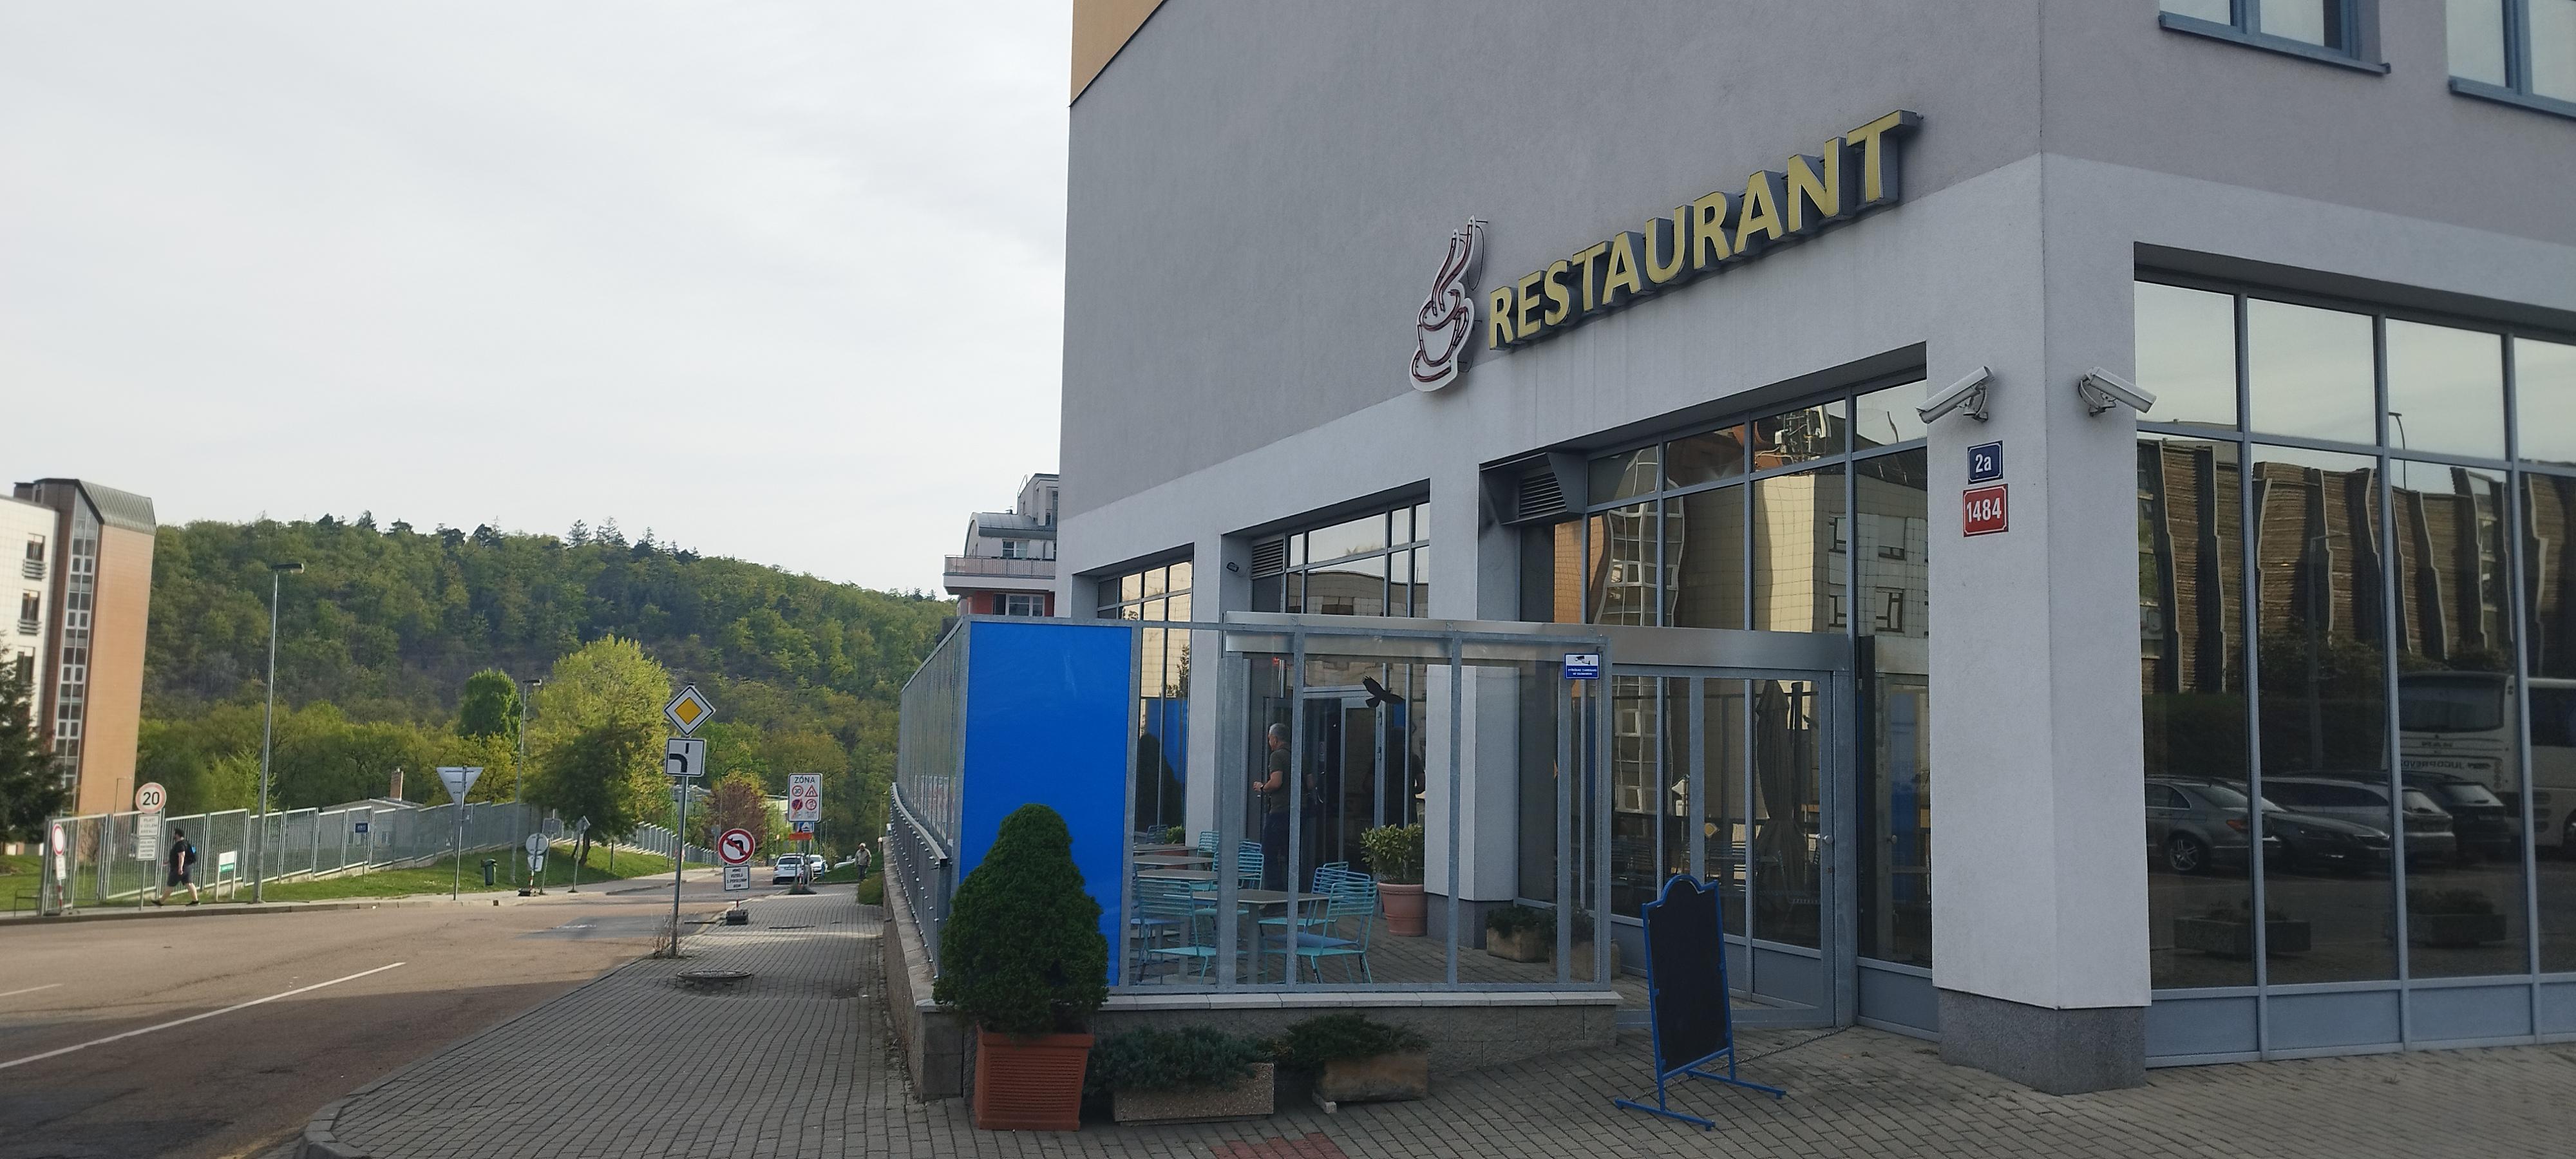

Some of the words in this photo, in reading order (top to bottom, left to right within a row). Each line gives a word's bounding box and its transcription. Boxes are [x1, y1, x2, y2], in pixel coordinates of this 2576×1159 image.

[1489, 109, 1905, 351] RESTAURANT
[1975, 453, 1992, 473] 2a
[1966, 497, 2002, 523] 1484
[794, 775, 815, 784] ZÓNA
[142, 791, 160, 806] 20
